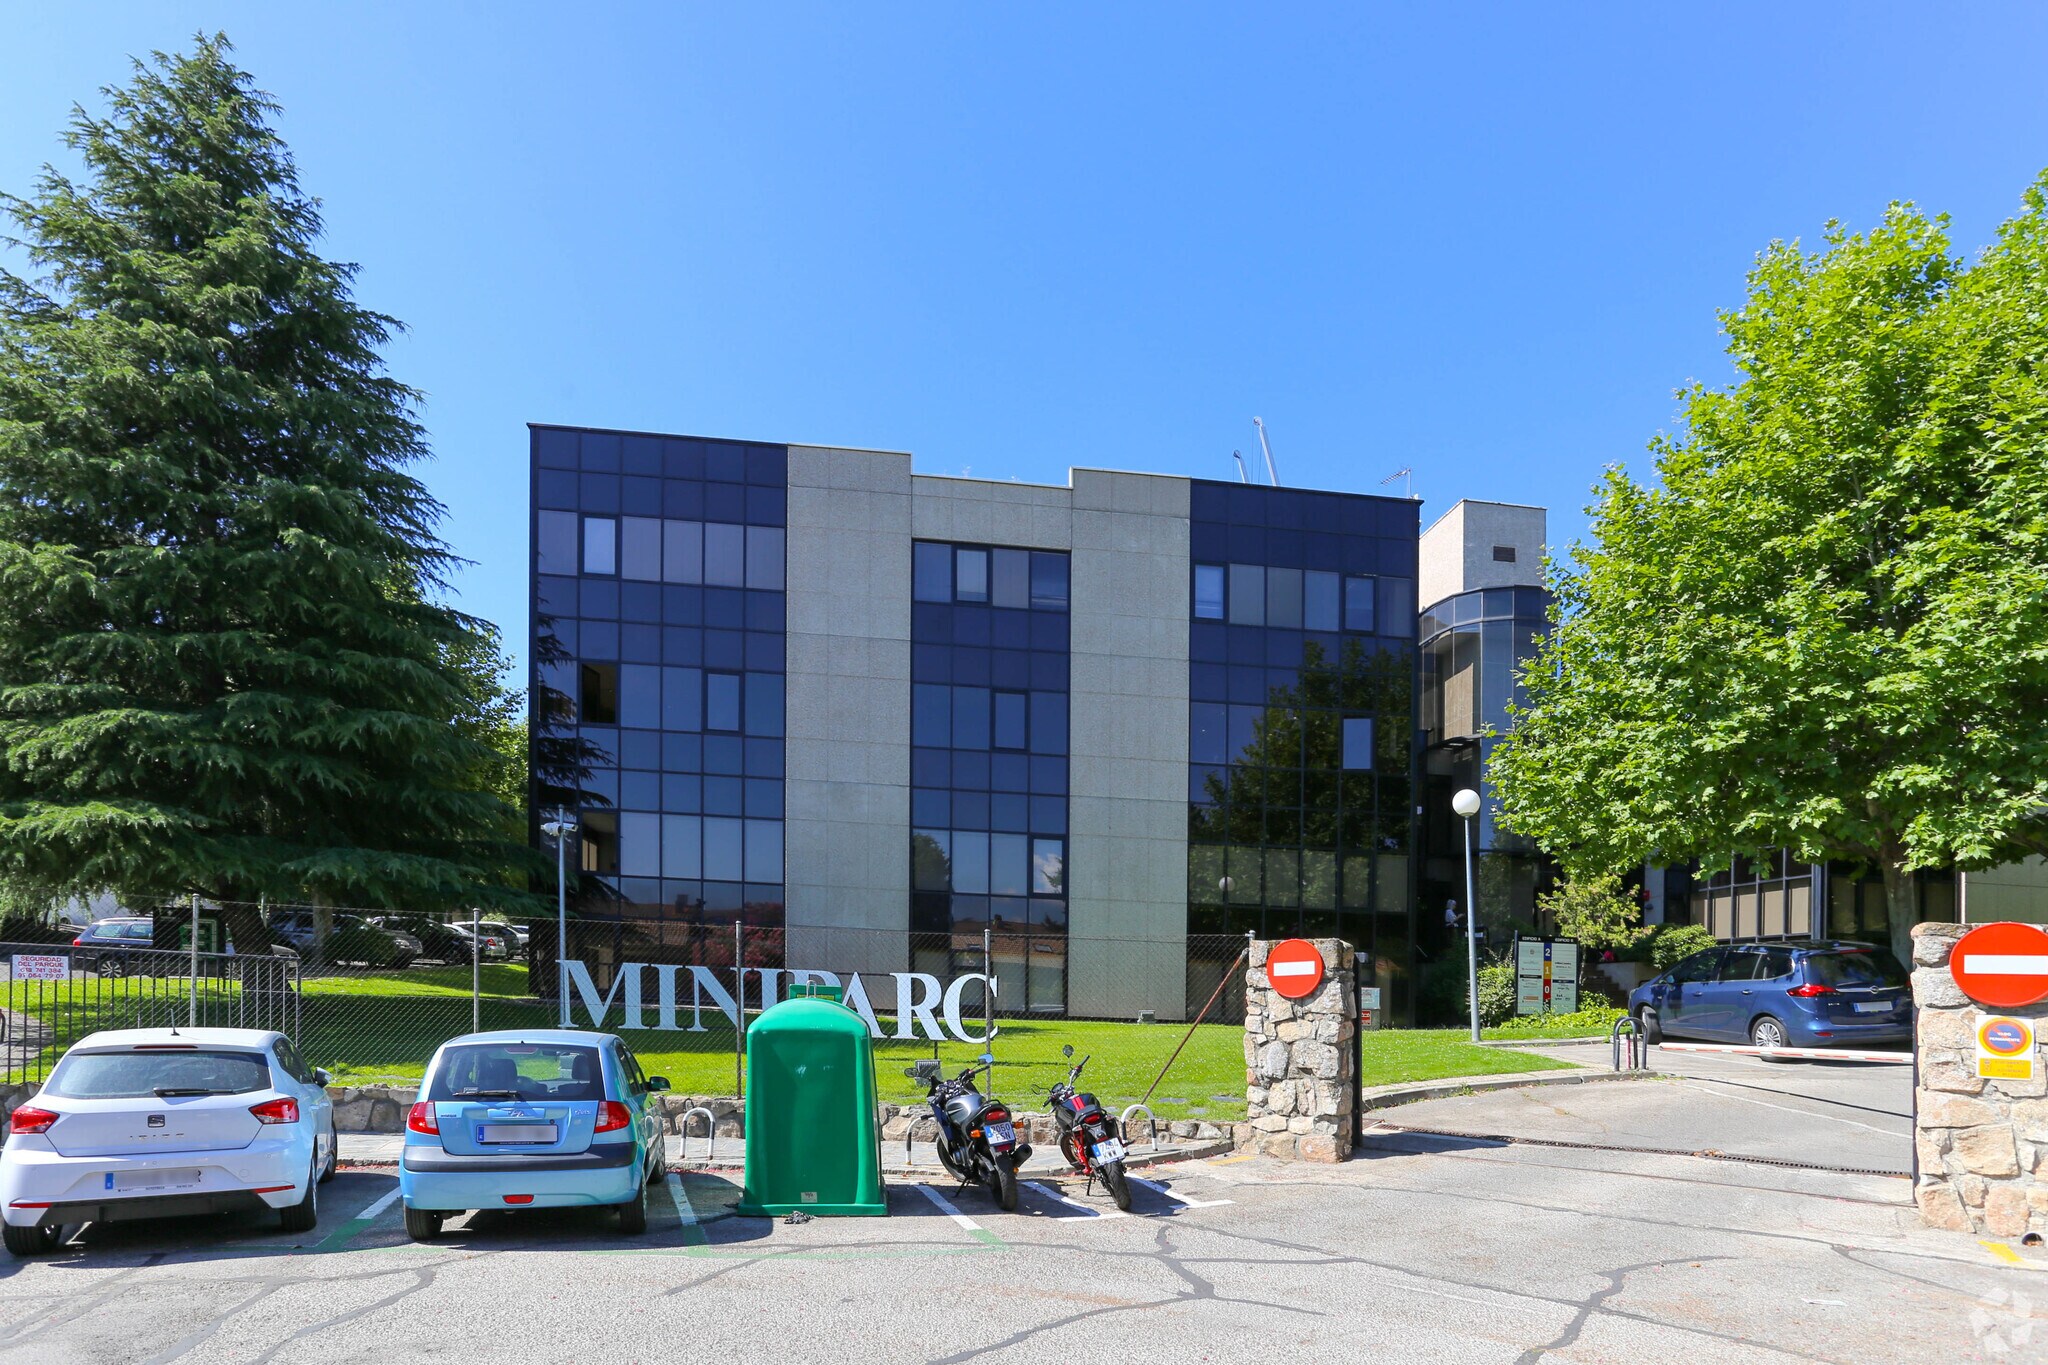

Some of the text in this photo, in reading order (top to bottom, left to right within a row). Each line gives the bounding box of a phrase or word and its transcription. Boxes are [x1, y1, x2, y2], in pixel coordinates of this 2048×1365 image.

[1545, 948, 1550, 956] 2
[1545, 967, 1550, 975] 1
[555, 959, 998, 1044] MINIARC
